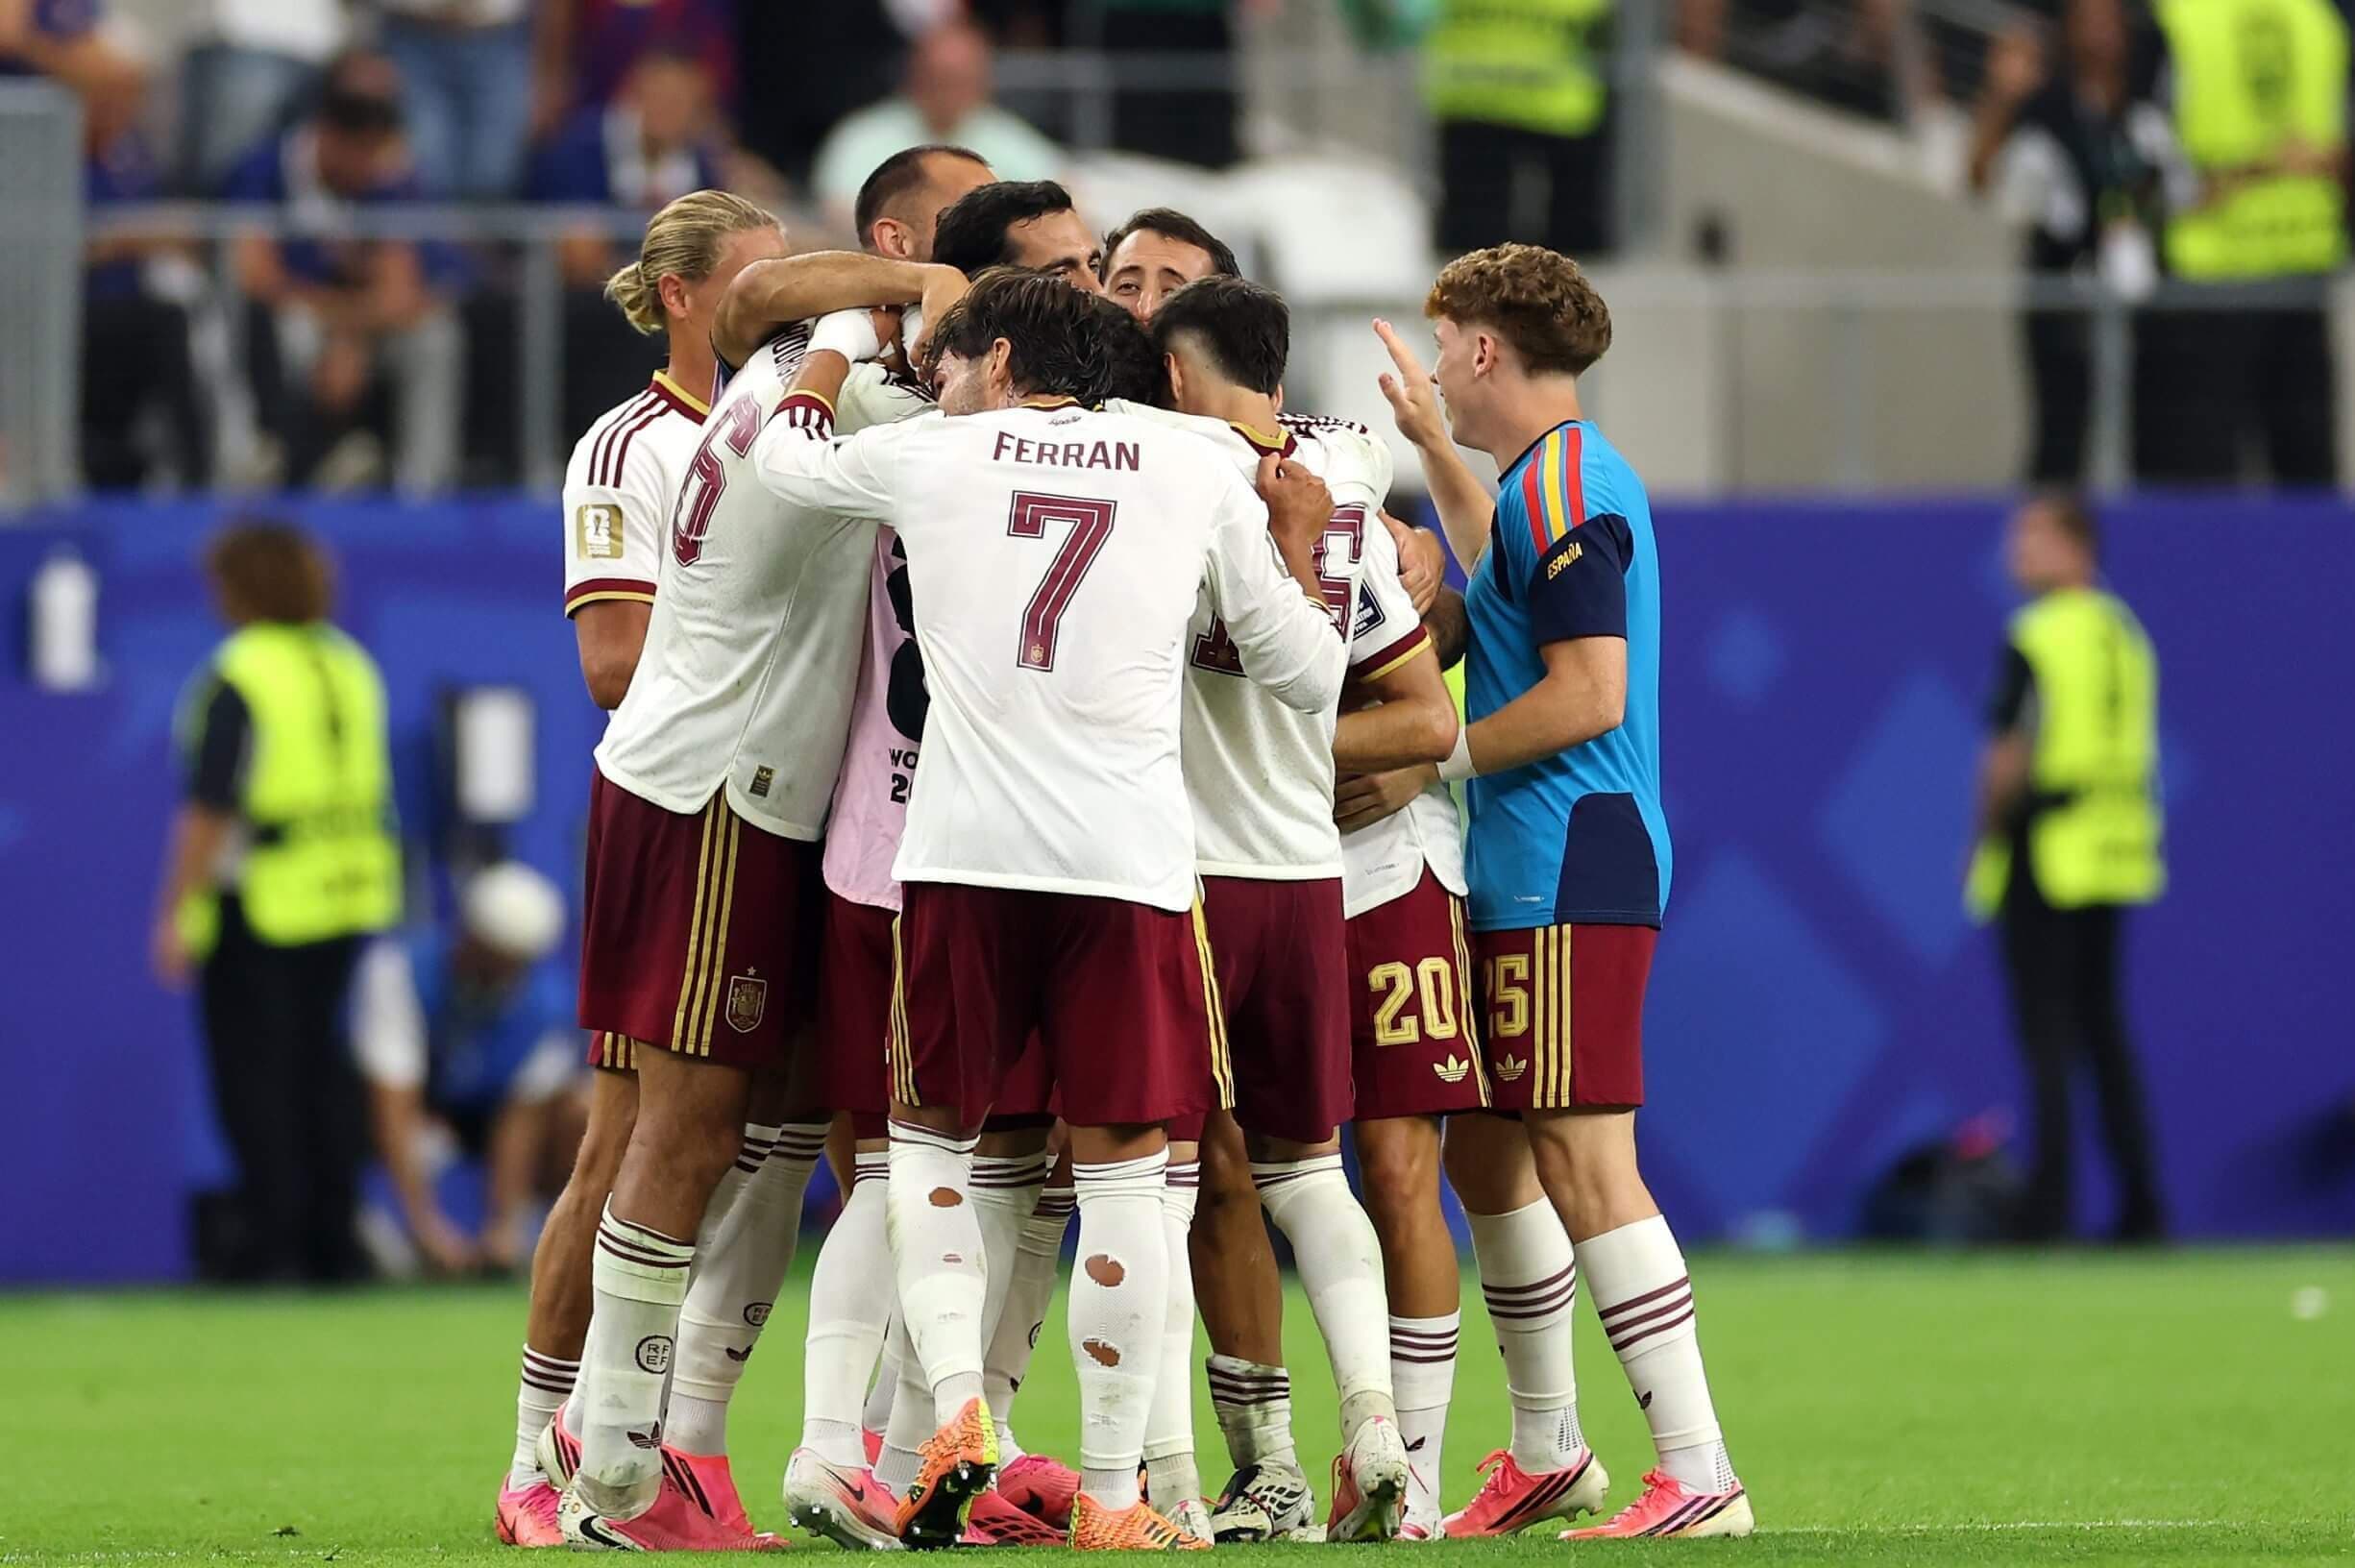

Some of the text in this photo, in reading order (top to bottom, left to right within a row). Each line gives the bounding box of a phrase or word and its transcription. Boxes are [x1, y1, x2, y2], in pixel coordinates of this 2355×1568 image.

[993, 430, 1140, 471] FERRAN
[1007, 490, 1117, 673] 7
[1547, 542, 1583, 580] ESPAÑA
[889, 747, 920, 770] WO
[890, 772, 913, 804] 2
[1367, 956, 1458, 1046] 20
[1484, 953, 1529, 1039] 5
